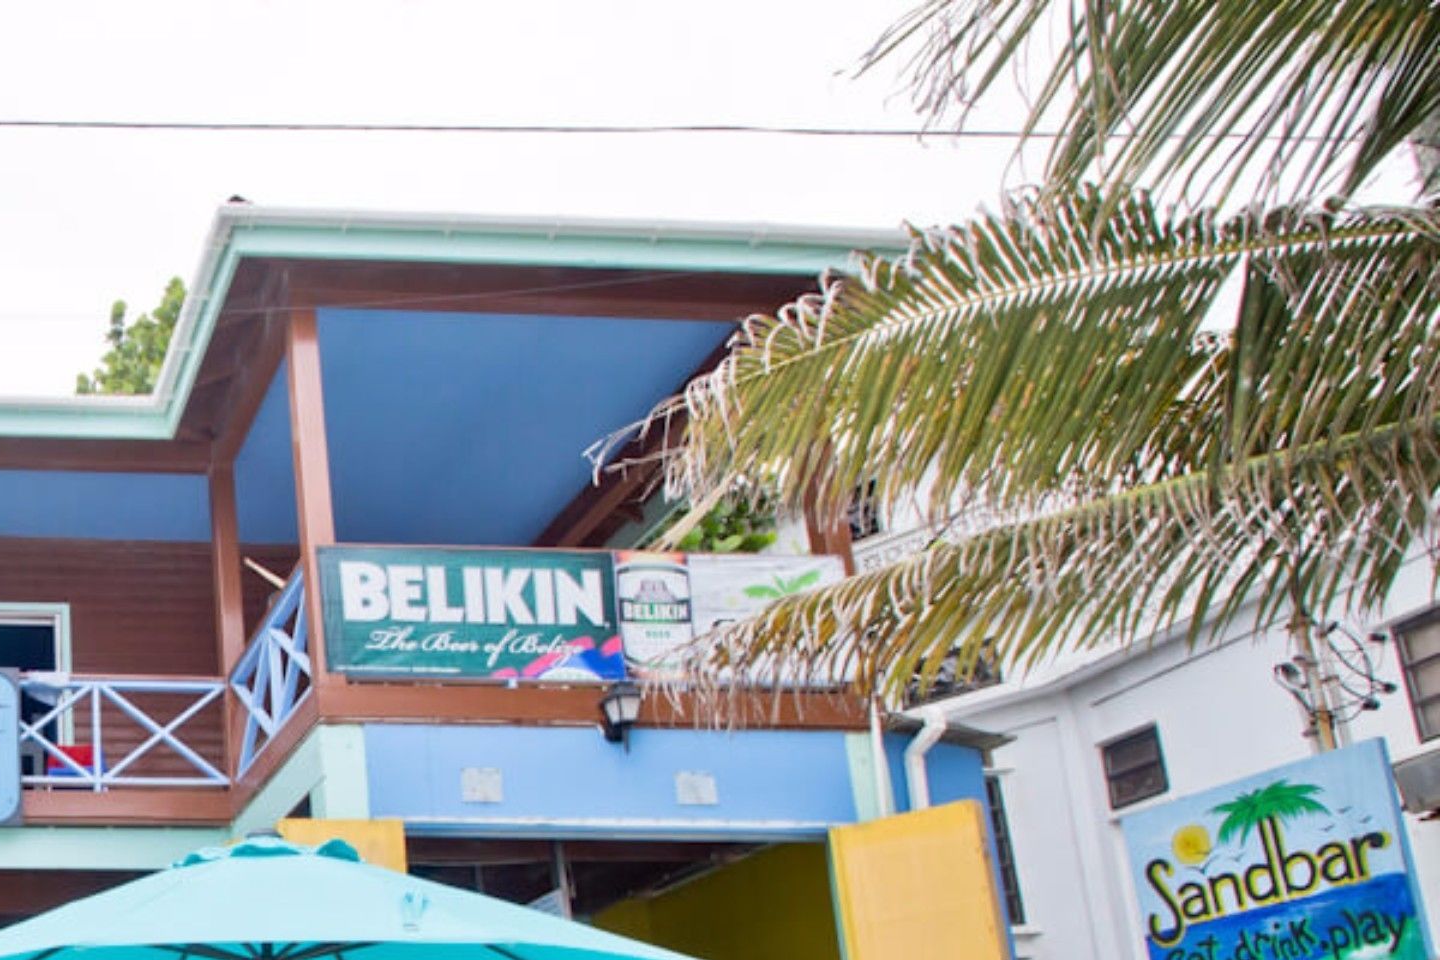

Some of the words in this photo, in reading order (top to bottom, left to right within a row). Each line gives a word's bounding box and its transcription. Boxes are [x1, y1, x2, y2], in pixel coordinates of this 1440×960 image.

[339, 560, 603, 626] BELIKIN
[364, 625, 417, 650] The
[422, 630, 478, 653] Beer
[480, 627, 517, 667] of
[1145, 816, 1390, 946] Sandbar
